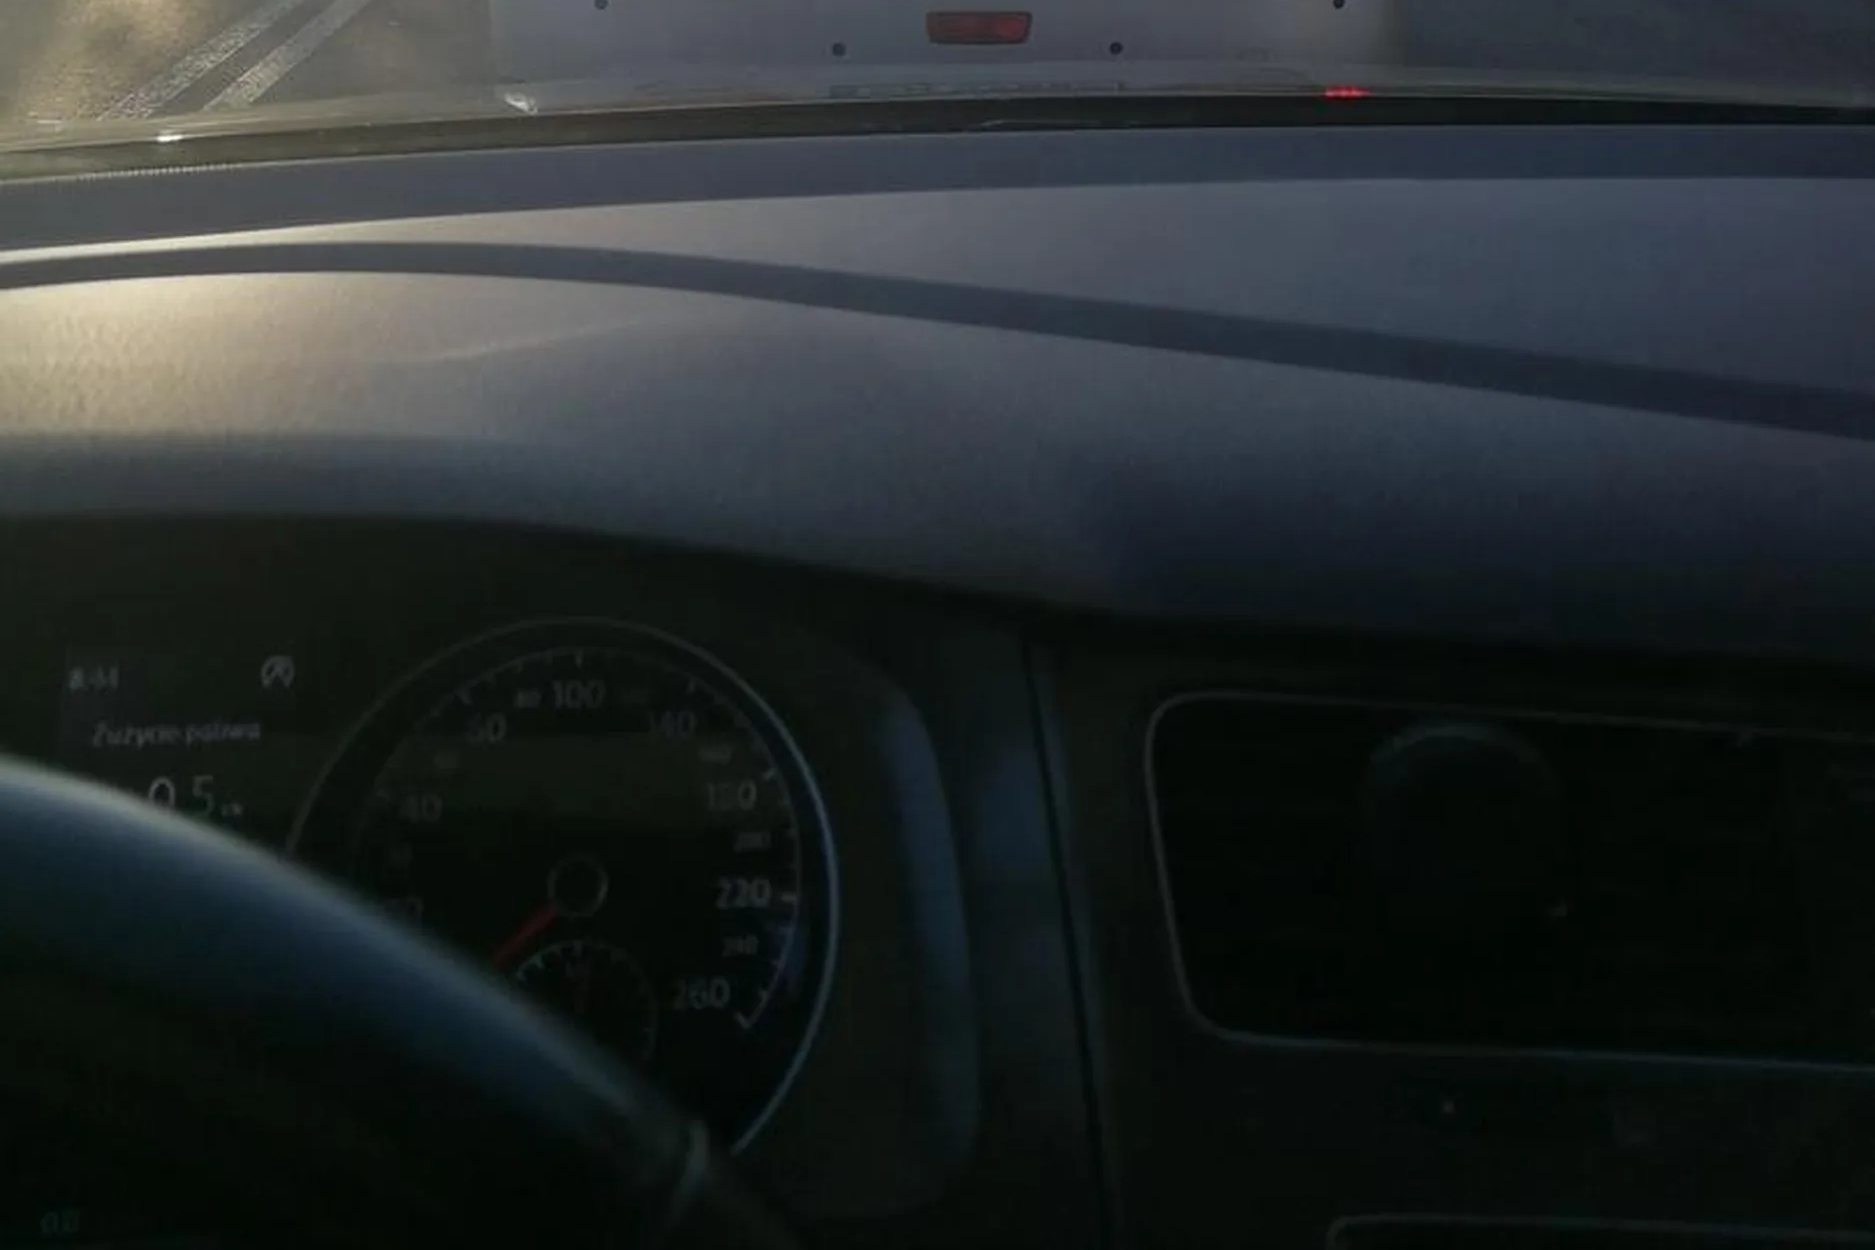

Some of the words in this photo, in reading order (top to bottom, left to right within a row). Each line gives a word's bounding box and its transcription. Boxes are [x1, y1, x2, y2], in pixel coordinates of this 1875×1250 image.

[553, 680, 606, 709] 100
[716, 876, 771, 910] 220
[672, 975, 731, 1011] 260
